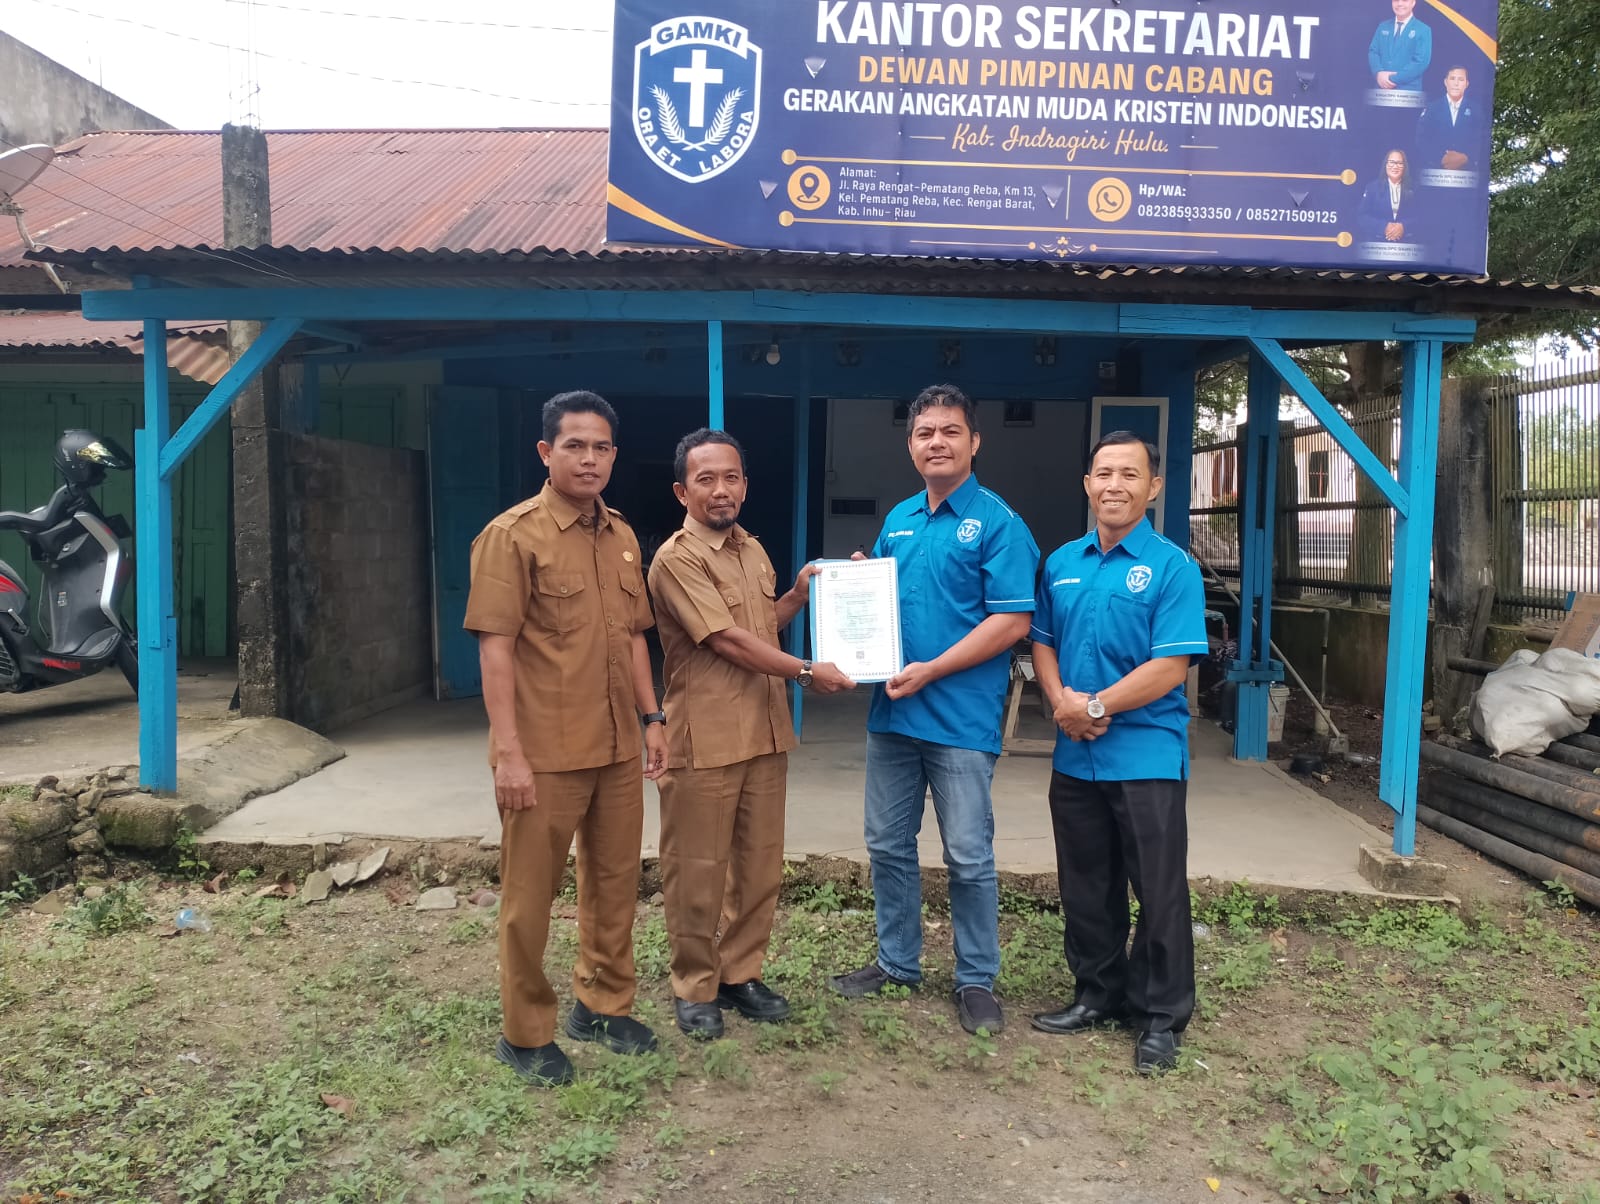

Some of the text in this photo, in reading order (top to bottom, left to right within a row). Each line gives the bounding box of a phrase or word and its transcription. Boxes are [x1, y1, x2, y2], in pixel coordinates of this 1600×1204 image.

[656, 21, 742, 48] GAMKI
[816, 0, 1320, 60] KANTOR SEKRETARIAT
[858, 55, 1273, 96] DEWAN PIMPINAN CABANG
[783, 87, 1348, 130] GERAKAN ANGKATAN MUDA KRISTEN INDONESIA
[638, 107, 754, 173] ORA ET LABORA
[951, 123, 995, 152] Kab.
[1001, 124, 1110, 162] Indragiri
[839, 166, 877, 178] Alamat:
[839, 180, 850, 190] Jl.
[852, 181, 876, 192] Raya
[973, 185, 1001, 196] Reba,
[1004, 185, 1020, 196] Km
[1023, 186, 1037, 197] 13,
[1139, 184, 1187, 198] Hp/WA:
[838, 193, 1036, 211] Kel. Pematang Reba, Kec. Rengat Barat,
[838, 206, 860, 216] Kab.
[894, 208, 917, 218] Riau
[1137, 204, 1338, 224] 082385933350 / 085271509125
